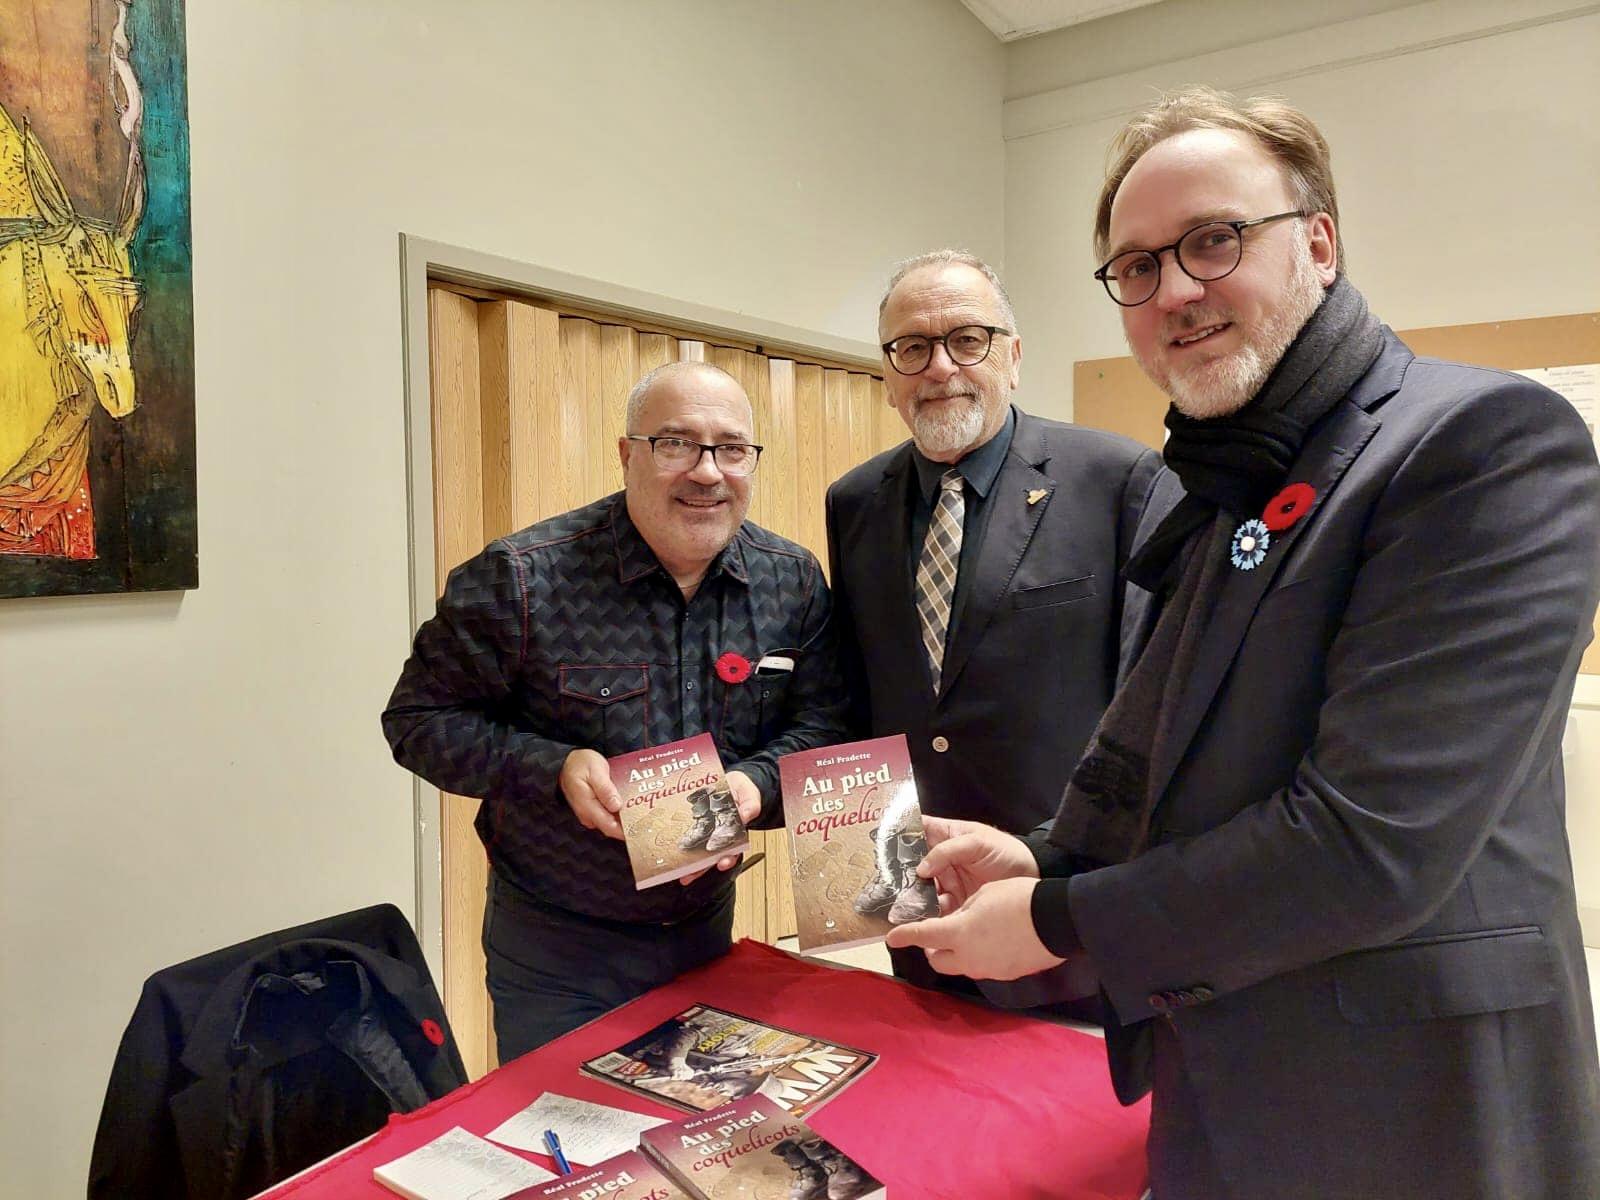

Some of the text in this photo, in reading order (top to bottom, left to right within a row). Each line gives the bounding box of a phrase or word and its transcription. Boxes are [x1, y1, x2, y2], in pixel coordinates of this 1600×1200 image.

[628, 752, 702, 783] Au pied
[816, 753, 871, 767] Réal Fradette
[626, 767, 719, 809] coquelicots
[638, 778, 665, 794] des
[803, 763, 892, 796] Au pied
[796, 786, 885, 841] coquelic
[811, 797, 844, 815] des
[681, 1110, 768, 1149] Au pied
[692, 1122, 800, 1172] coquelicots
[699, 1137, 733, 1155] des
[577, 1170, 637, 1200] pied
